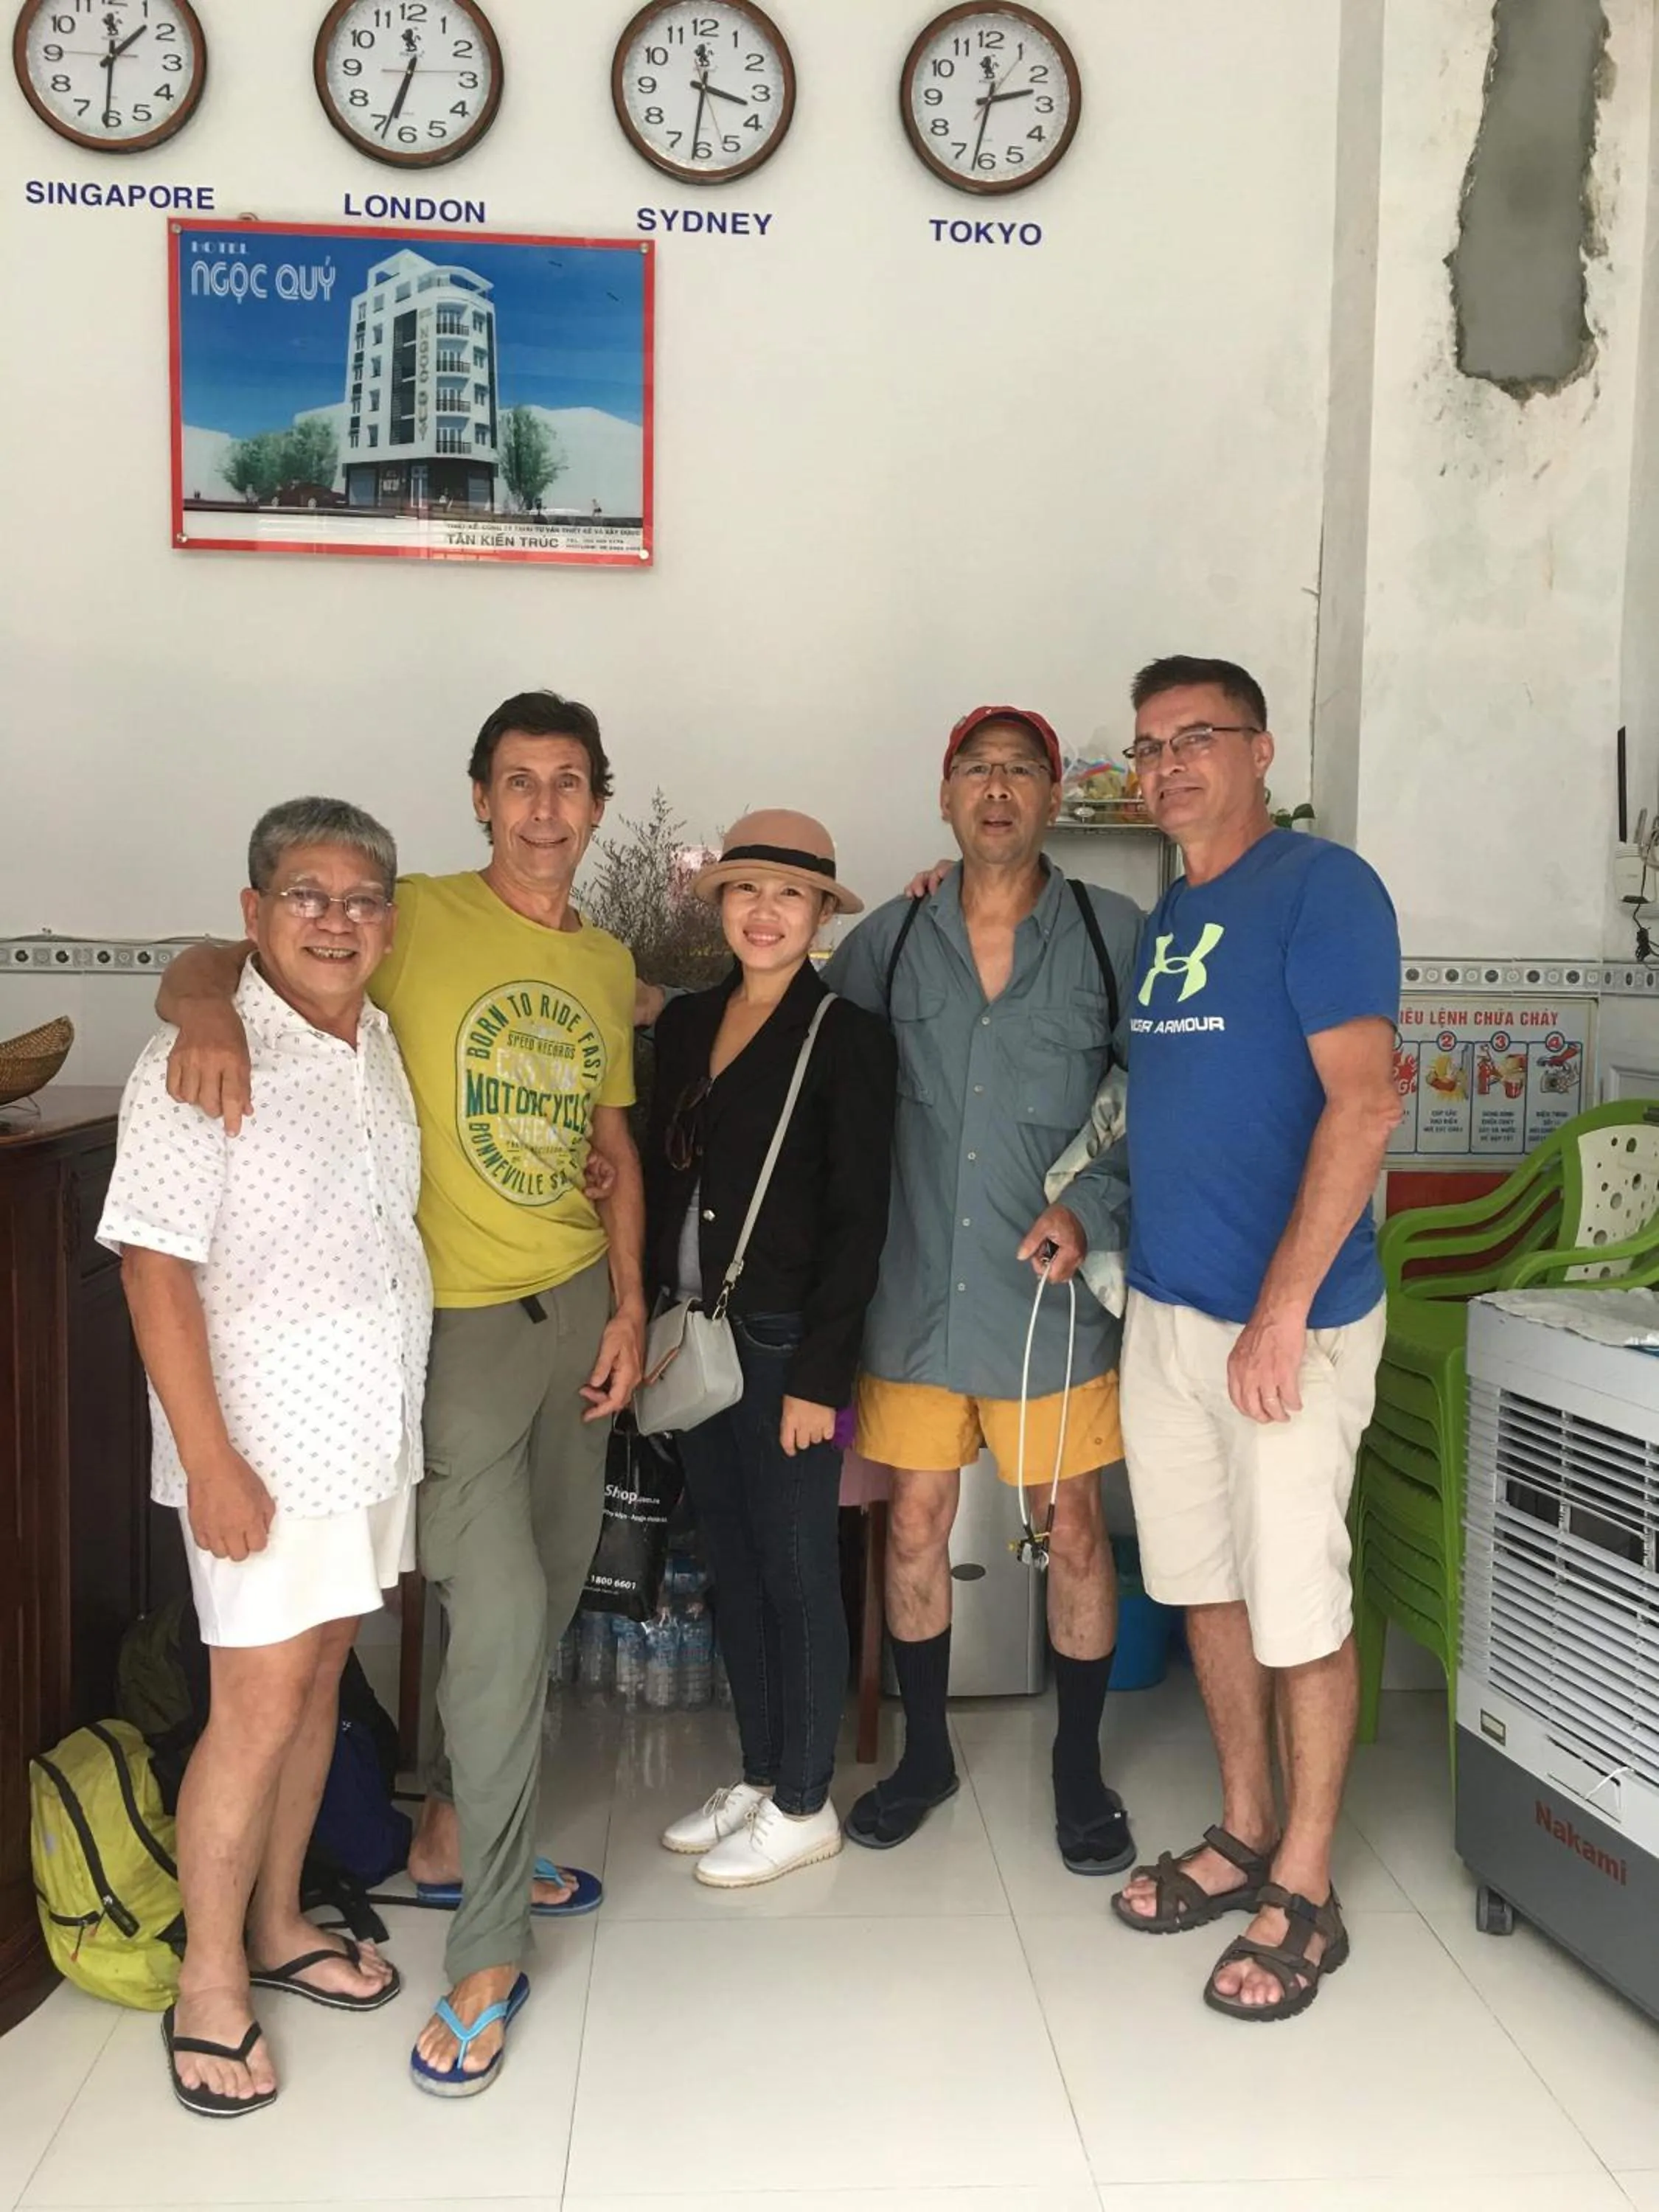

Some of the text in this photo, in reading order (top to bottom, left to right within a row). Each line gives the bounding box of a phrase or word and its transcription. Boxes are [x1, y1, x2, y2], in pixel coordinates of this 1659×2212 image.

[142, 0, 148, 18] 1
[400, 3, 427, 22] 12
[52, 15, 76, 34] 10
[374, 9, 391, 28] 11
[440, 16, 447, 35] 1
[692, 18, 720, 37] 12
[155, 23, 175, 41] 2
[350, 29, 375, 49] 10
[667, 26, 684, 44] 11
[732, 30, 739, 48] 1
[978, 30, 1005, 49] 12
[43, 44, 63, 62] 9
[452, 40, 473, 58] 2
[644, 46, 669, 66] 10
[953, 38, 970, 57] 11
[1018, 43, 1023, 61] 1
[162, 54, 183, 72] 3
[343, 58, 362, 76] 9
[744, 53, 765, 72] 2
[931, 59, 955, 78] 10
[51, 74, 72, 92] 8
[458, 71, 479, 89] 3
[1029, 65, 1048, 84] 2
[153, 83, 174, 100] 4
[638, 76, 657, 94] 9
[751, 84, 771, 102] 3
[349, 88, 369, 107] 8
[924, 88, 943, 105] 9
[1035, 96, 1054, 114] 3
[74, 98, 91, 116] 7
[132, 104, 152, 122] 5
[449, 100, 470, 117] 4
[644, 106, 664, 125] 8
[102, 111, 122, 128] 6
[370, 114, 387, 131] 7
[742, 114, 762, 131] 4
[930, 118, 949, 136] 8
[397, 126, 417, 144] 6
[427, 120, 448, 138] 5
[1026, 125, 1046, 142] 4
[666, 131, 683, 148] 7
[721, 135, 742, 153] 5
[695, 142, 713, 159] 6
[951, 142, 967, 160] 7
[1005, 145, 1024, 164] 5
[977, 153, 996, 170] 6
[26, 181, 215, 210] SINGAPORE
[344, 193, 486, 223] LONDON
[636, 207, 773, 236] SYDNEY
[929, 220, 1043, 246] TOKYO
[191, 240, 249, 254] HOTEL
[191, 255, 335, 305] NGỌC QUÝ
[519, 535, 559, 548] TRÚC
[1154, 1017, 1225, 1034] ARMOUR
[1399, 1007, 1424, 1026] IÊU
[1430, 1007, 1468, 1028] LỆNH
[467, 1004, 509, 1060] BORN
[507, 992, 532, 1018] TO
[540, 994, 582, 1033] RIDE
[577, 1032, 601, 1082] FAST
[1441, 1034, 1453, 1047] 2
[1495, 1035, 1506, 1048] 3
[1548, 1036, 1560, 1047] 4
[507, 1034, 575, 1060] SPEED RECORDS
[469, 1122, 543, 1194] BONNEVILLE
[591, 1574, 613, 1586] 1800
[1535, 1800, 1627, 1885] Nakami
